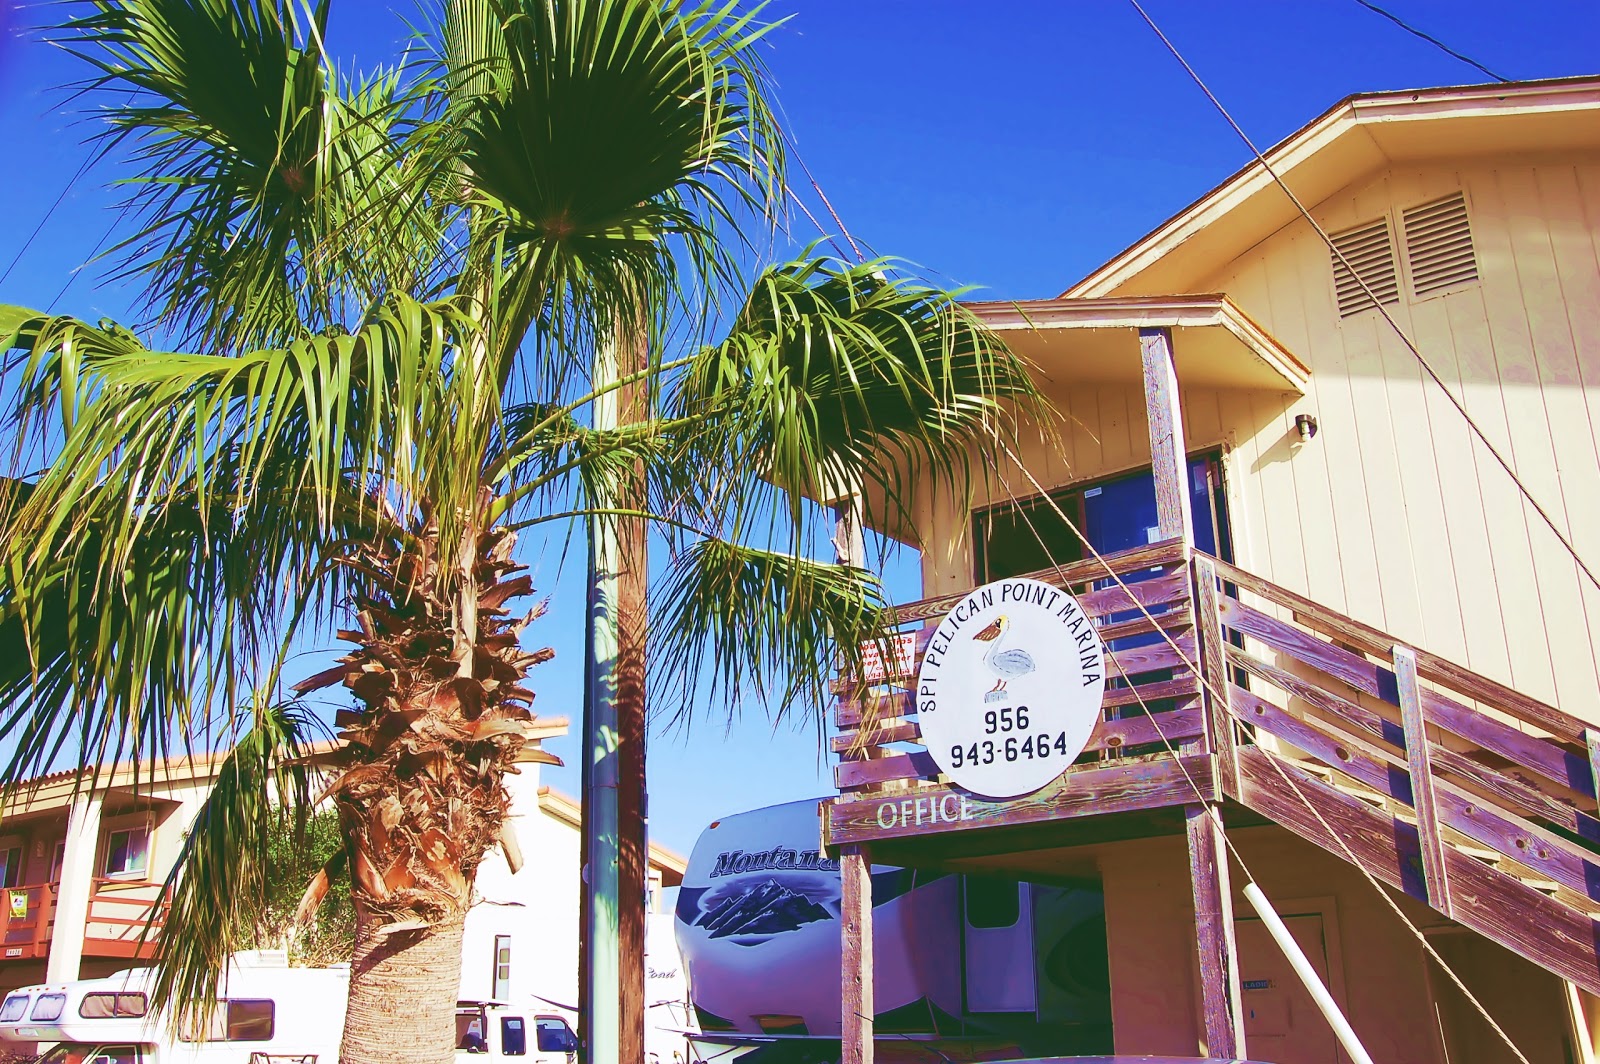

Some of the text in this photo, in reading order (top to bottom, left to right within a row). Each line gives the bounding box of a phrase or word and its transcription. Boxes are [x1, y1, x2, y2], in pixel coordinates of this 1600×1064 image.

[920, 583, 1101, 713] SPI PELICAN POINT MARINA
[984, 705, 1030, 734] 956
[951, 731, 1067, 768] 943-6464
[876, 793, 974, 830] OFFICE
[710, 845, 840, 878] Montana
